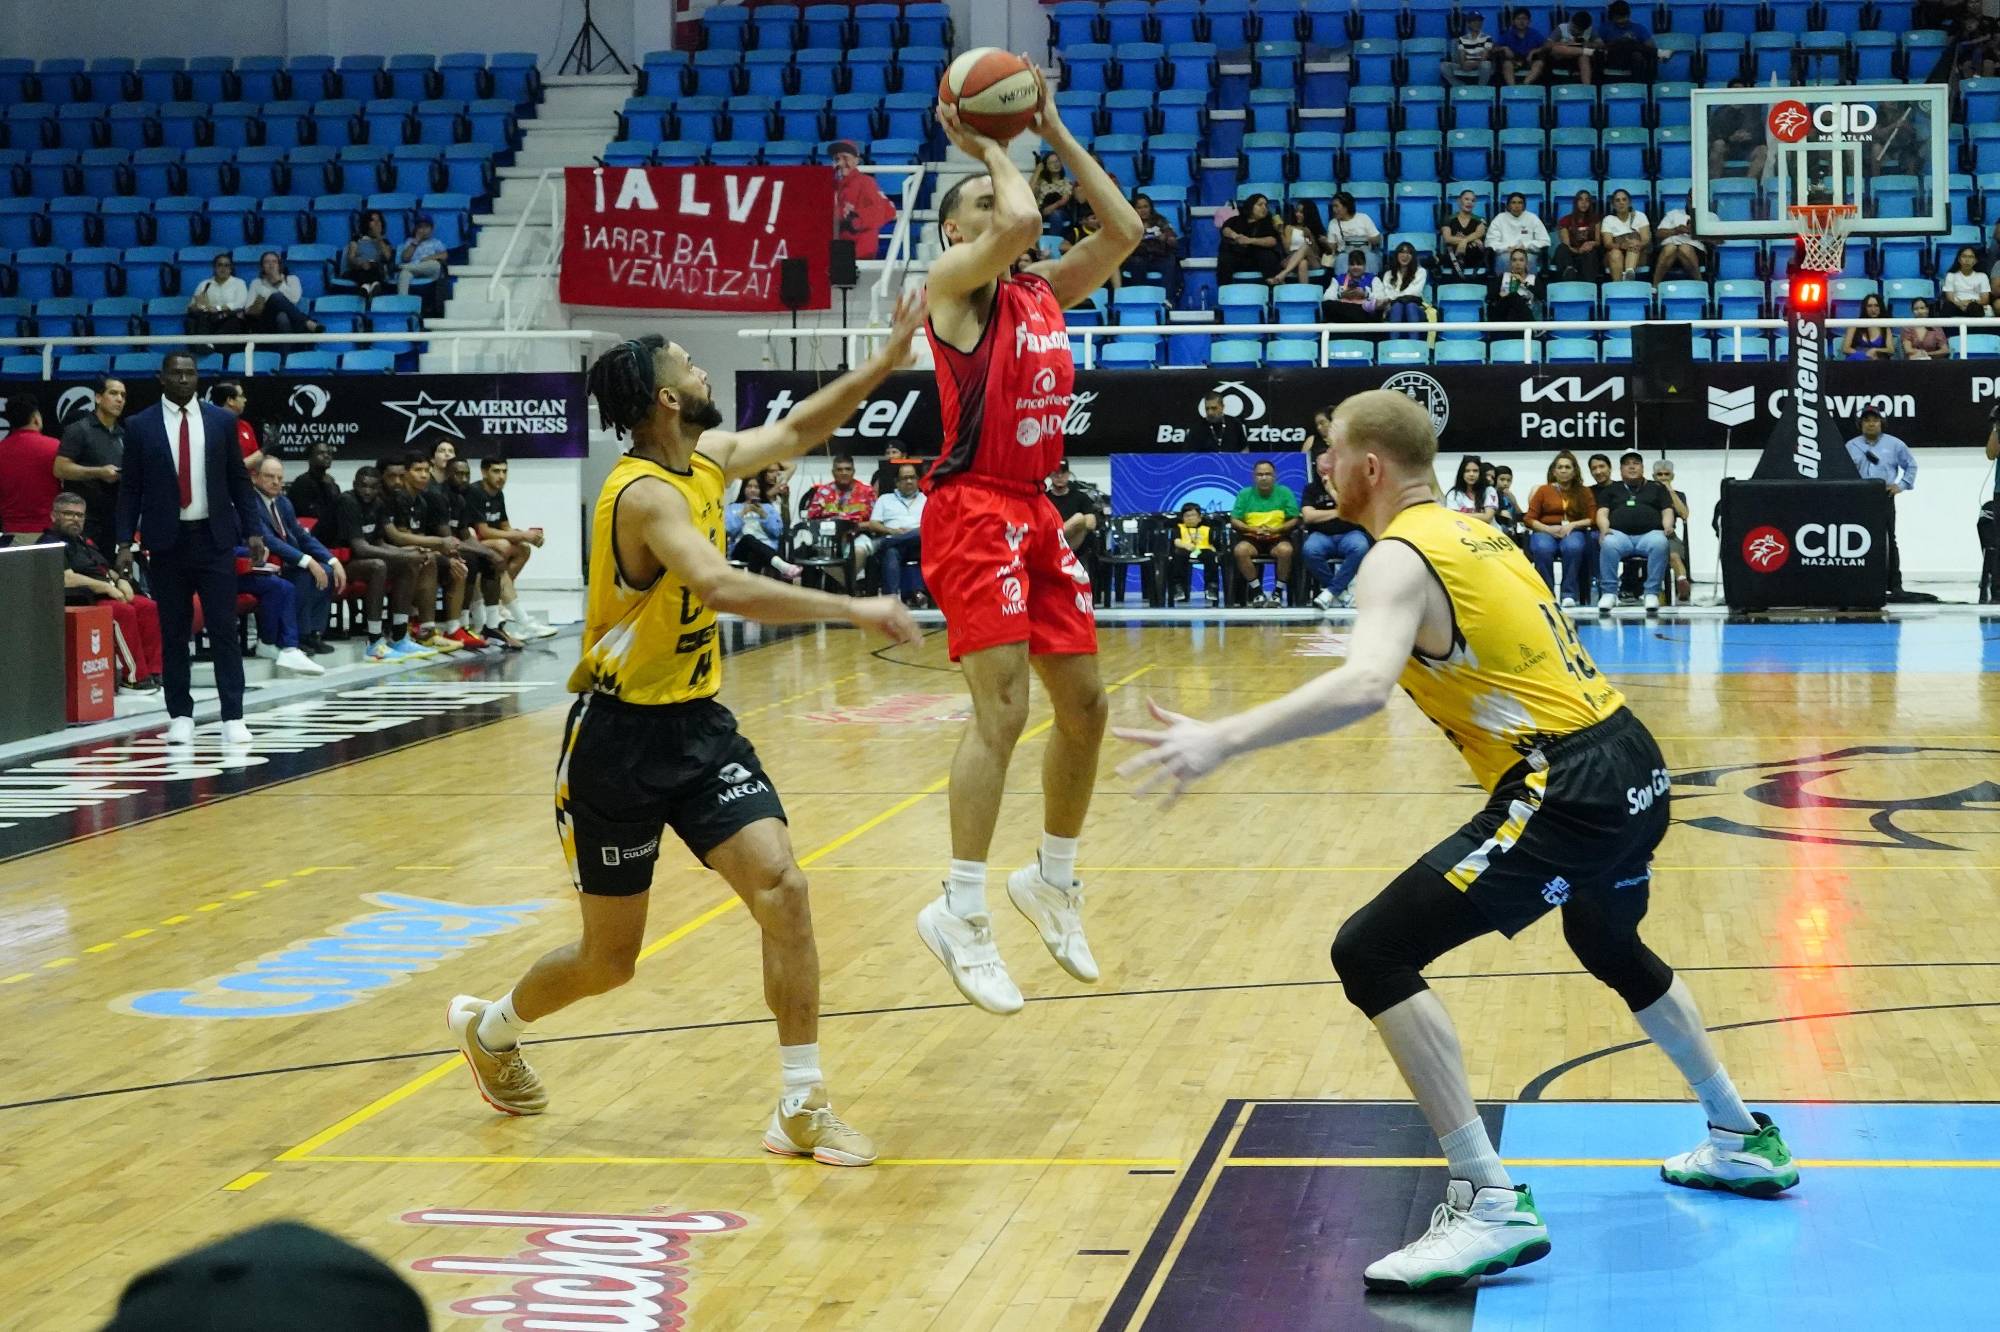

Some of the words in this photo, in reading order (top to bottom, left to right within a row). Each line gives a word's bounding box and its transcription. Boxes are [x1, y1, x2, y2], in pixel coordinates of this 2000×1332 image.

[1813, 104, 1877, 132] CID
[749, 238, 789, 270] LA
[608, 257, 771, 299] VENADIZA!
[454, 400, 566, 417] AMERICAN
[1768, 389, 1916, 418] Cvron
[1793, 318, 1822, 479] dportenis
[301, 423, 359, 433] ACUARIO
[482, 418, 568, 434] FITNESS
[1520, 412, 1625, 438] Pacific
[1795, 523, 1872, 557] CID
[1801, 558, 1865, 566] MAZATLAN
[717, 780, 770, 805] MEGA
